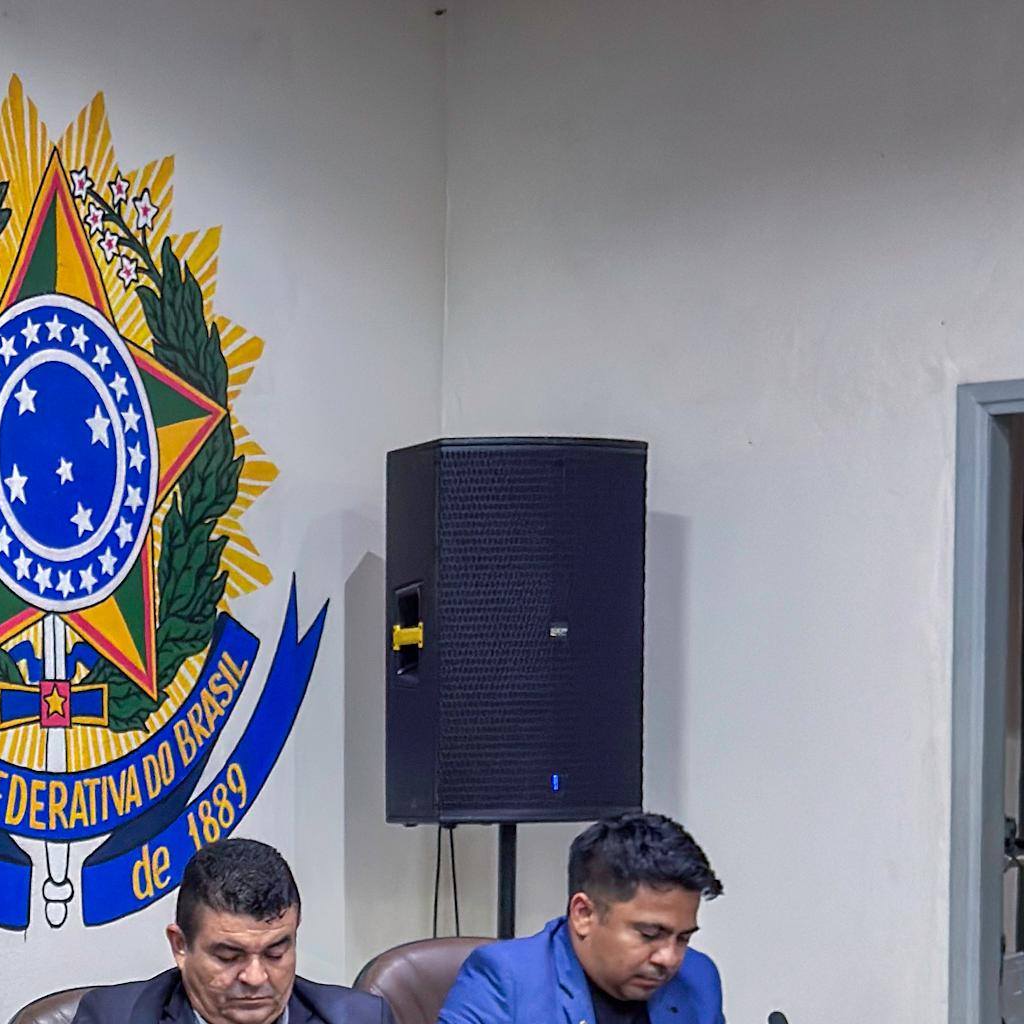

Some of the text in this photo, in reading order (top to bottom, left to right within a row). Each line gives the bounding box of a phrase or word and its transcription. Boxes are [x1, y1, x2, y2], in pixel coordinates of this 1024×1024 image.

[142, 741, 175, 800] DO
[173, 651, 249, 768] BRASIL
[132, 763, 247, 900] de 1889
